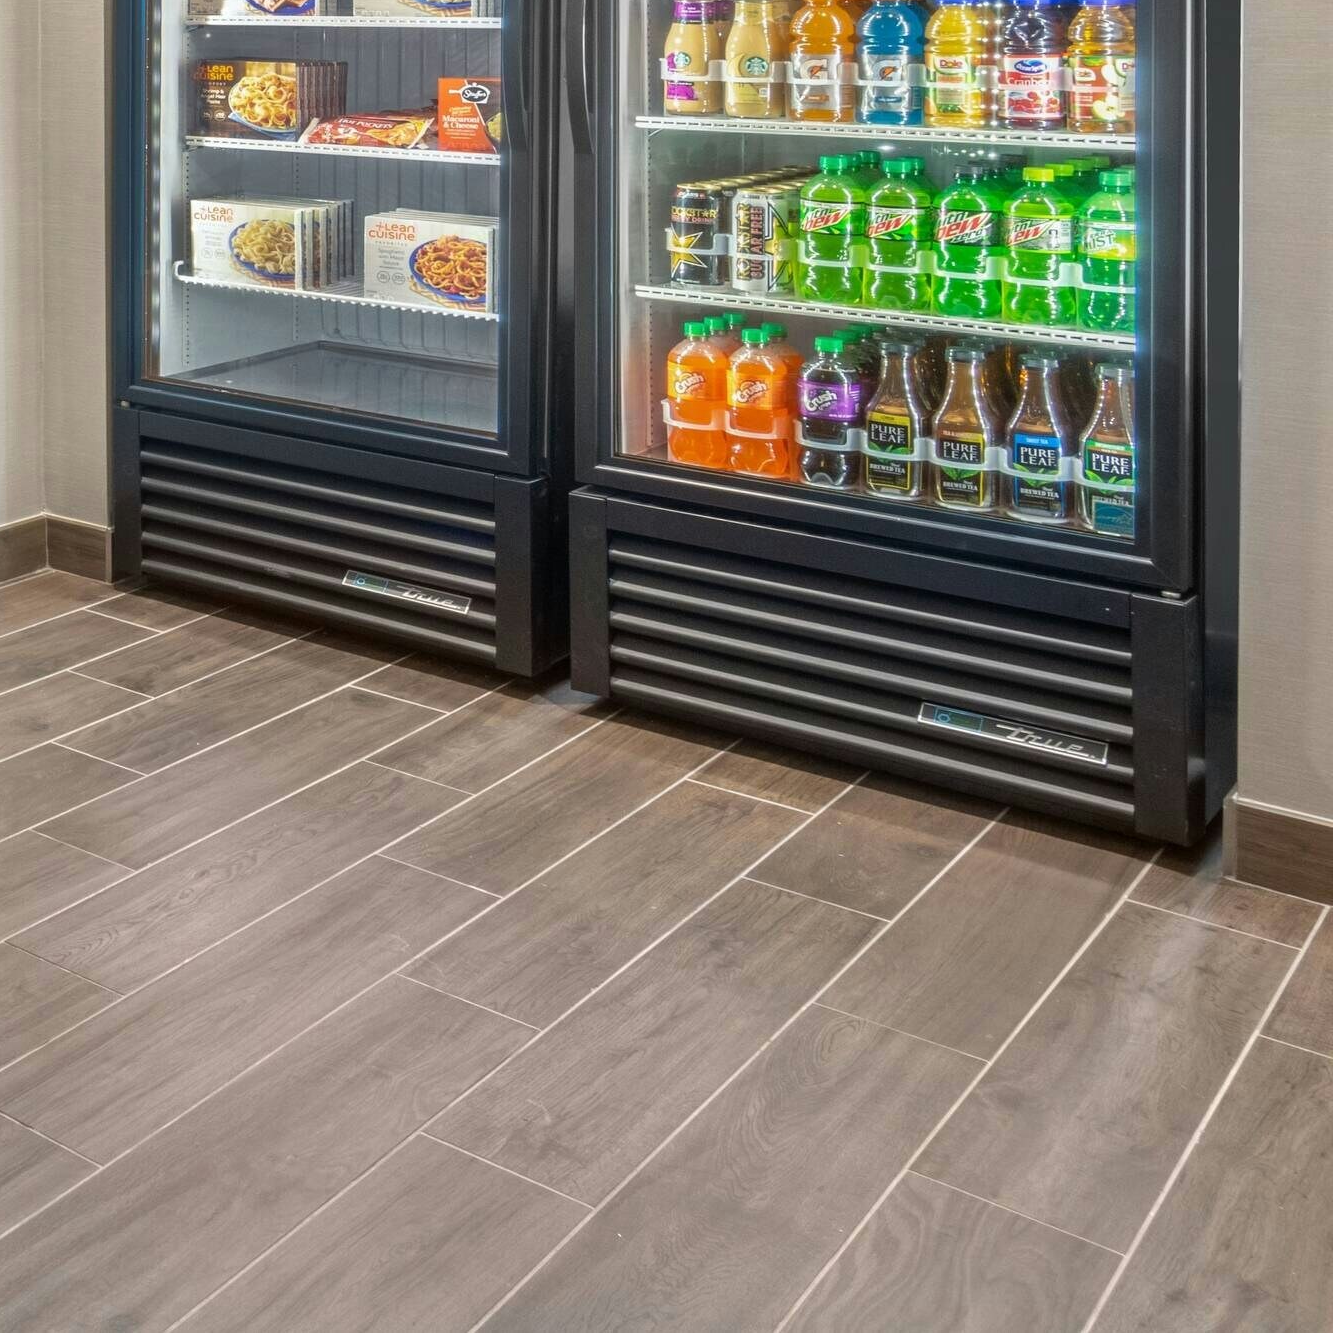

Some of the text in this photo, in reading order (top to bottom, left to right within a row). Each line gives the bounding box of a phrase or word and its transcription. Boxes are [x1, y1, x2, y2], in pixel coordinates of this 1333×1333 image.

[207, 65, 233, 73] Lean
[939, 59, 963, 69] Dole
[207, 205, 234, 215] Lean
[750, 206, 763, 237] FREE
[385, 223, 415, 233] Lean
[675, 373, 704, 394] Crush
[732, 381, 767, 403] Crush
[805, 390, 837, 411] Crush
[871, 424, 903, 434] PURE
[871, 432, 904, 444] LEAF
[943, 441, 977, 453] PURE
[1020, 446, 1056, 459] PURE
[1092, 453, 1130, 466] PURE
[943, 481, 978, 492] BREWED TEA
[1020, 488, 1046, 496] BREWED
